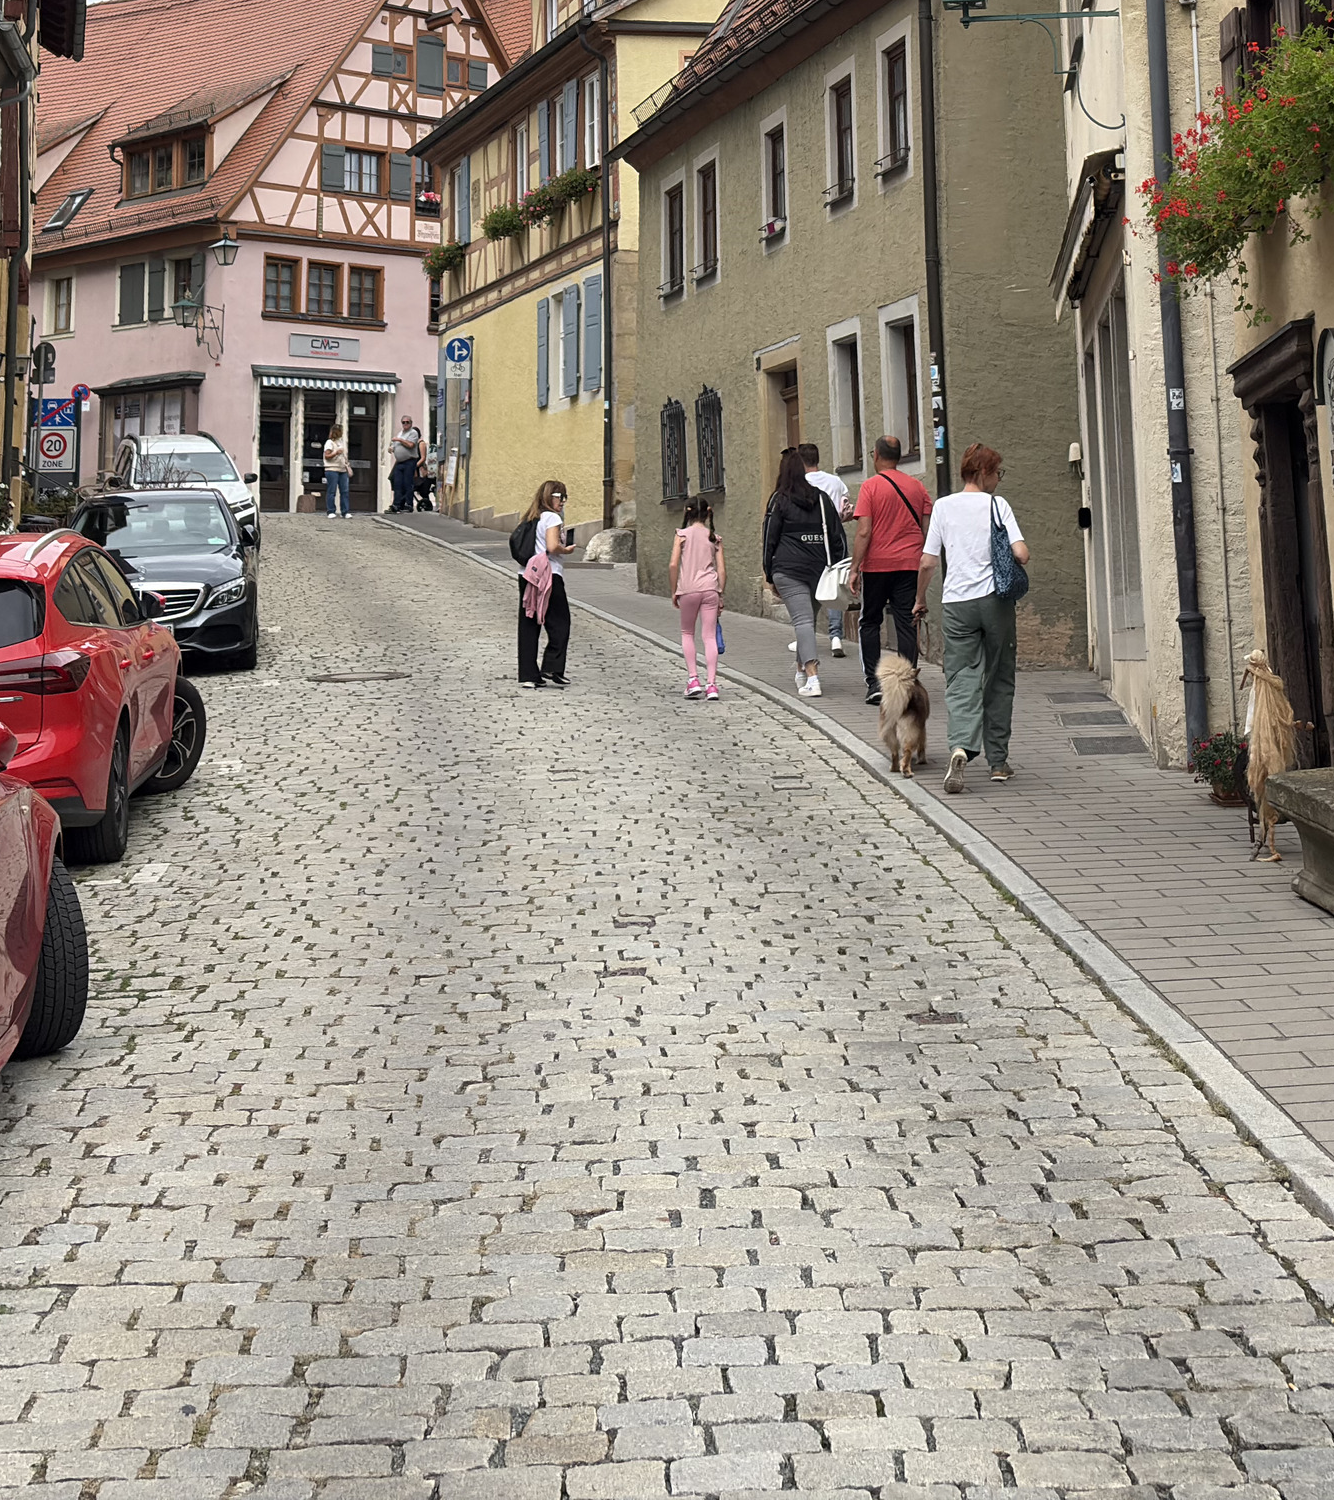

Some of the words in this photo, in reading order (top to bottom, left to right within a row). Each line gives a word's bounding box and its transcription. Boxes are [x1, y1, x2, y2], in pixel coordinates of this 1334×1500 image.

[46, 439, 61, 452] 20
[42, 460, 63, 468] ZONE
[801, 534, 824, 542] GUES
